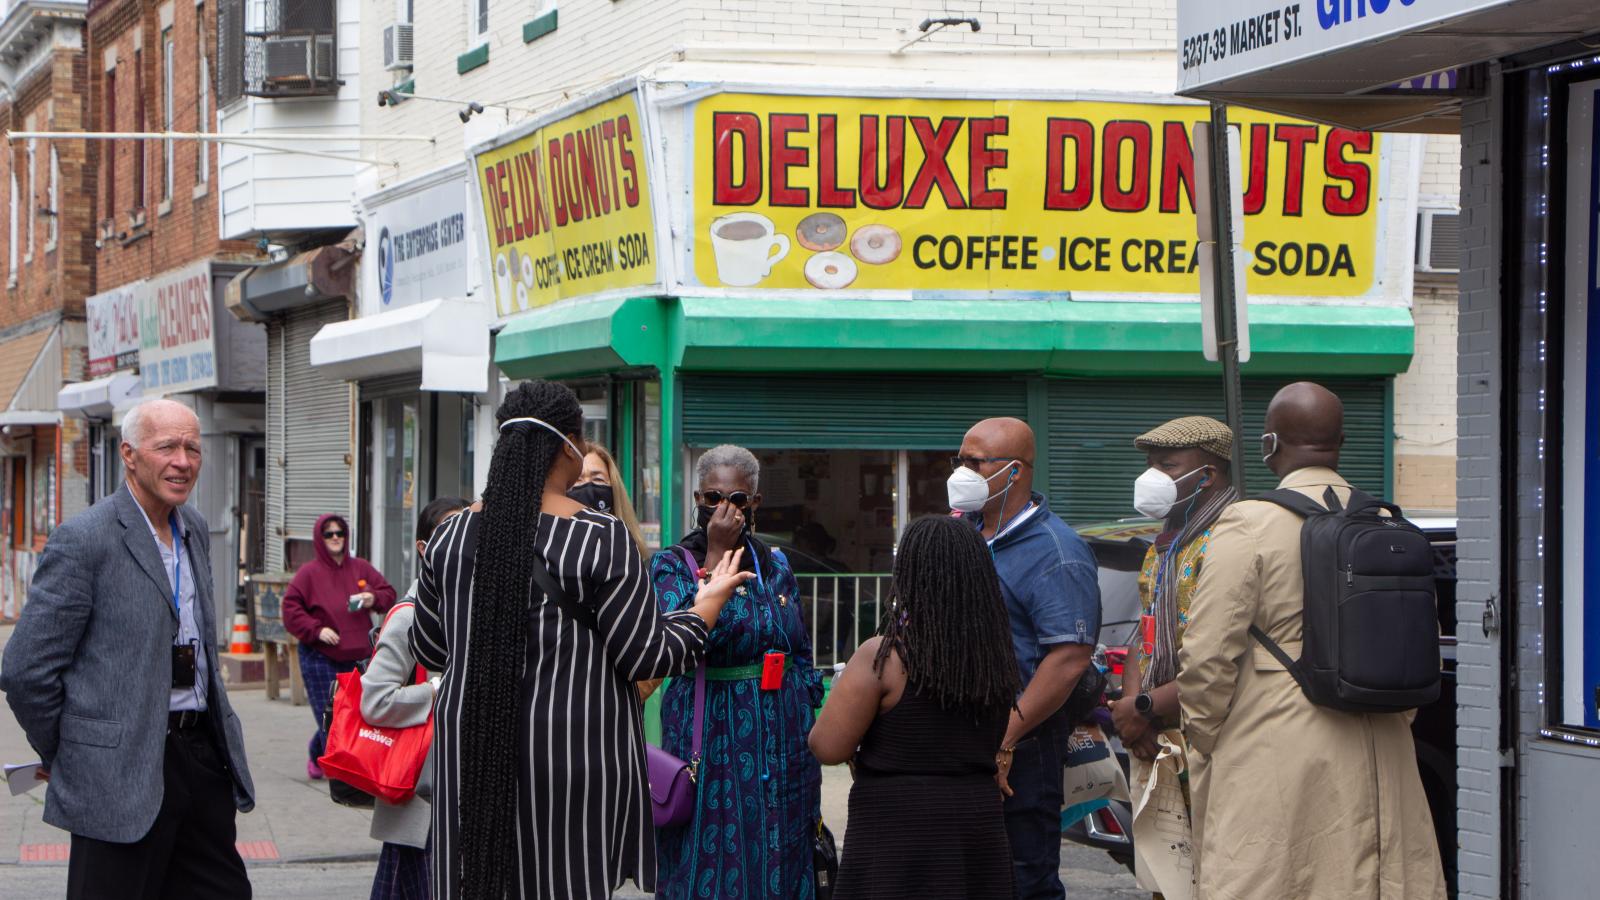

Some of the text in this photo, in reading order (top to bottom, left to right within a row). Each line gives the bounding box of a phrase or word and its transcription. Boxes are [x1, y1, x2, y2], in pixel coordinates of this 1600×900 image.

[1183, 27, 1226, 70] 5237-39
[1230, 10, 1281, 56] MARKET
[1284, 4, 1302, 41] ST.
[549, 114, 640, 227] DONUTS
[713, 111, 1374, 217] DELUXE DONUTS
[394, 212, 464, 263] THE ENTERPRISE CENTER
[563, 247, 583, 280] ICE
[582, 239, 614, 278] CREAM
[618, 231, 650, 270] SODA
[912, 234, 1038, 270] COFFEE
[1059, 236, 1111, 272] ICE
[1253, 241, 1356, 277] SODA
[159, 273, 210, 349] CLEANERS
